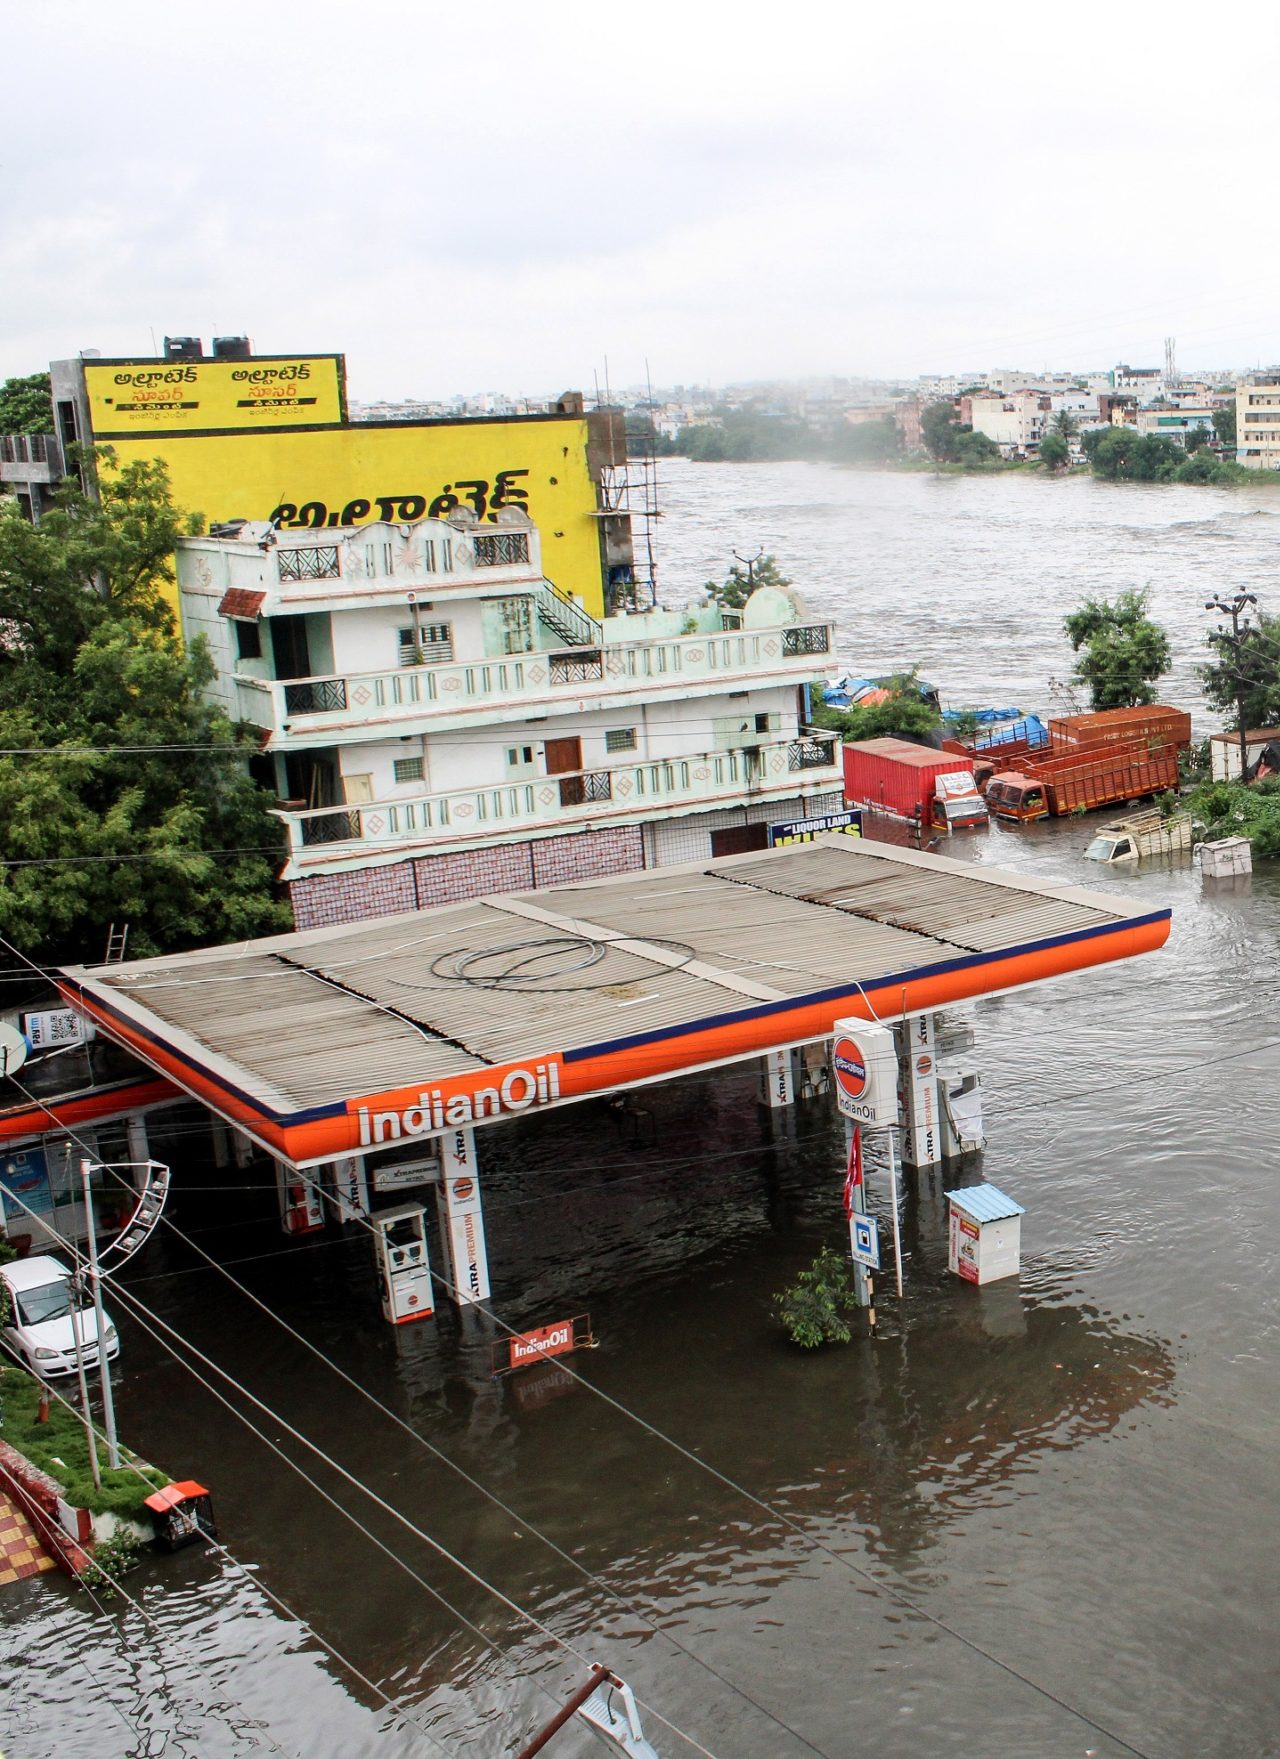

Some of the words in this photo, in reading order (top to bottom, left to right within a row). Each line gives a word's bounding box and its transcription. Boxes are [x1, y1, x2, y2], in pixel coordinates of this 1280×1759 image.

[792, 819, 827, 834] LIQUOR
[827, 815, 851, 827] LAND
[358, 1062, 560, 1146] IndianOil
[839, 1094, 876, 1121] IndianOil
[923, 1087, 934, 1162] XTRAPREMIUM
[464, 1213, 480, 1298] XTRAPREMIUM
[514, 1328, 568, 1358] IndianOil
